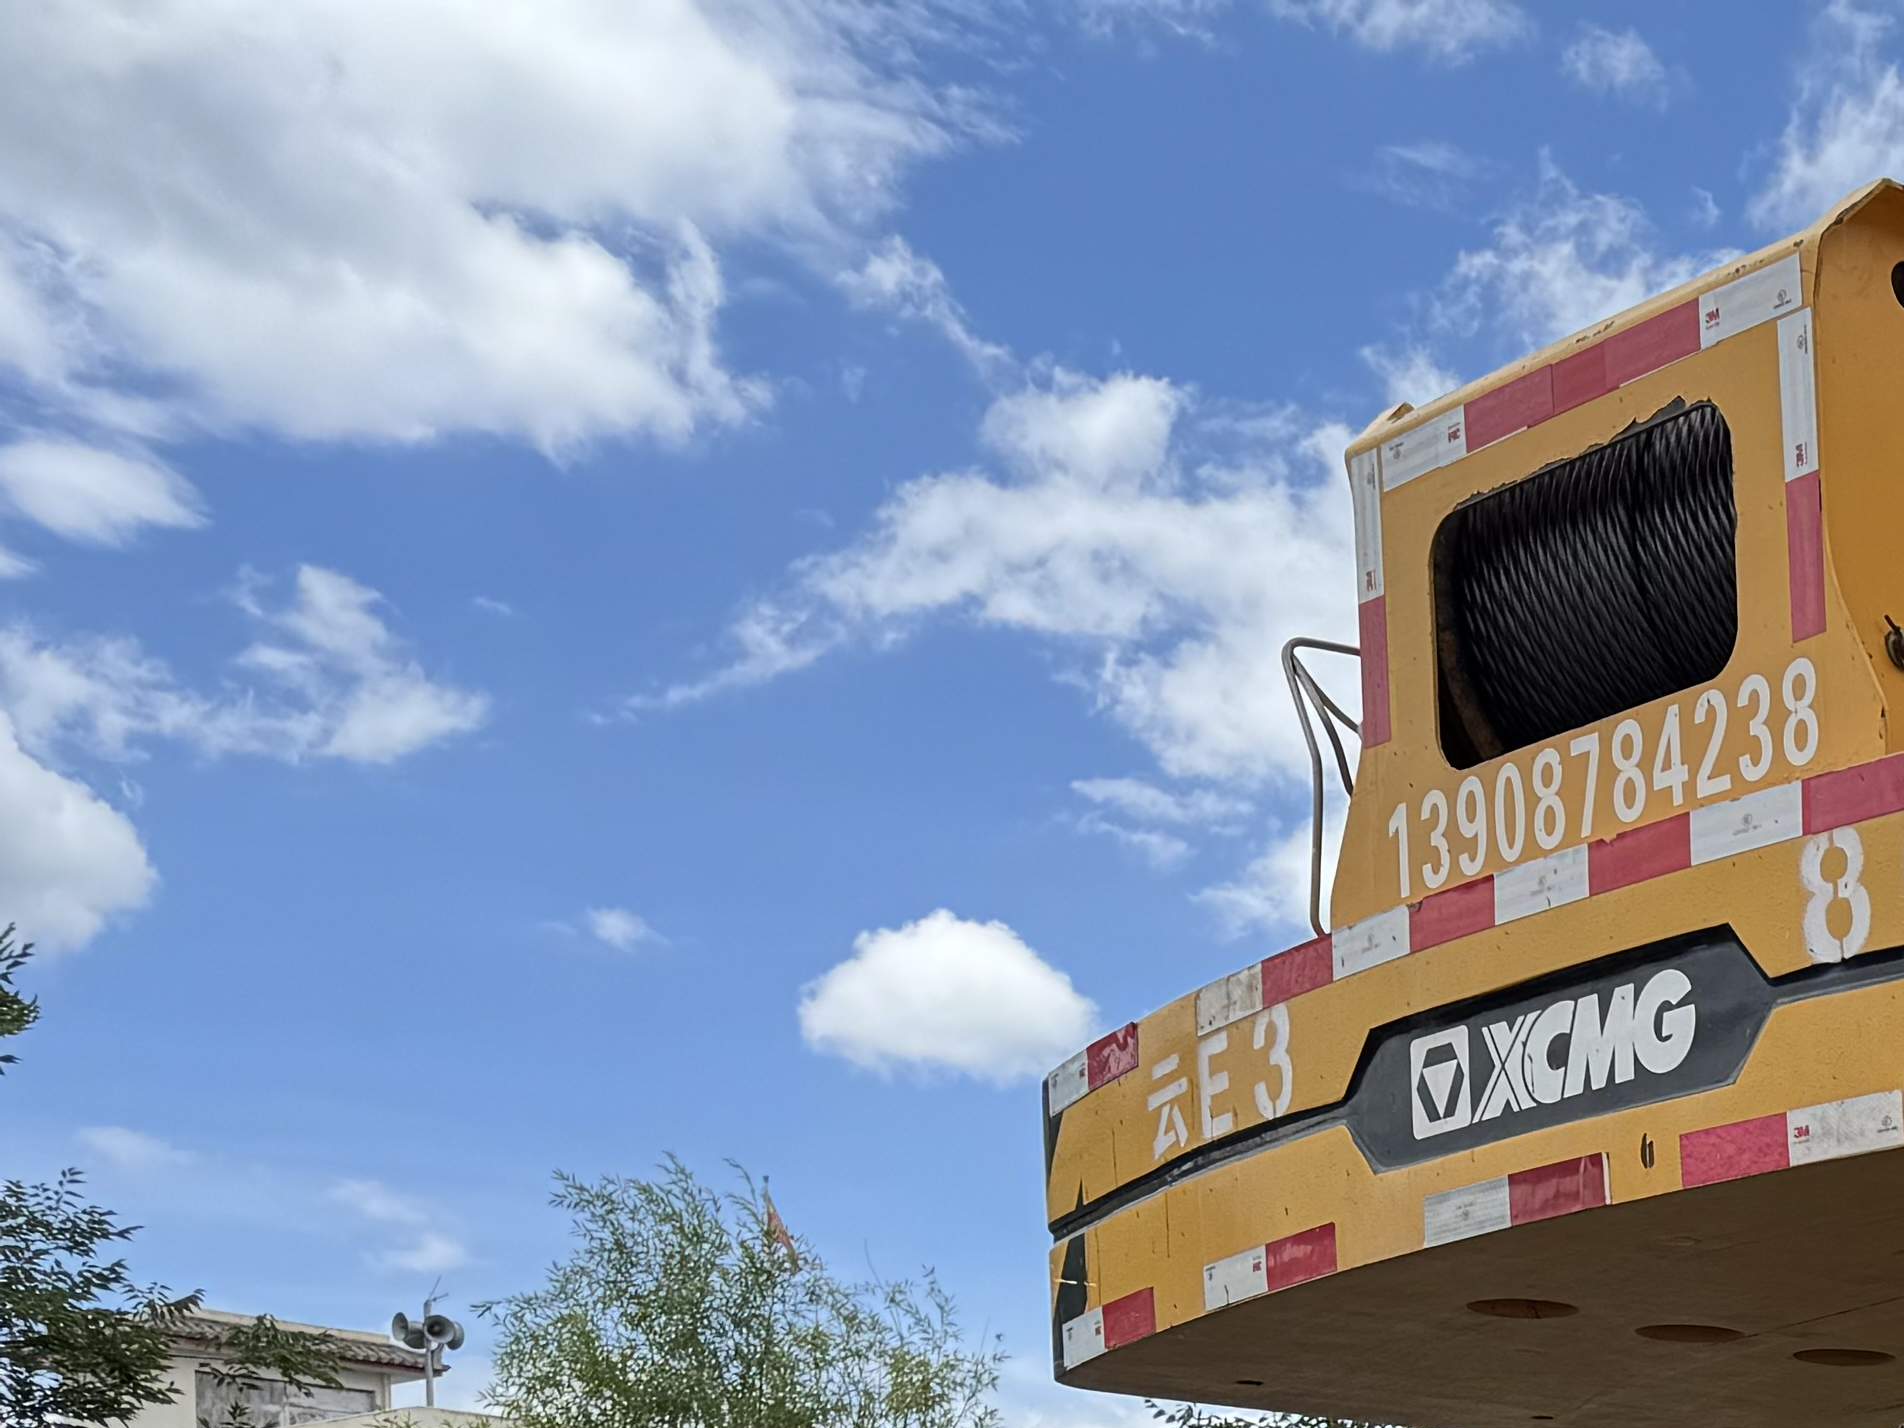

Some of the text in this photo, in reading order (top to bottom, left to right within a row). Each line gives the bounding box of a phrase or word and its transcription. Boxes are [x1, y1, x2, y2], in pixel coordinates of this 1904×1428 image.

[1705, 308, 1720, 324] 3M
[1388, 657, 1819, 898] 13908784238
[1472, 968, 1696, 1124] XCMG
[1794, 1125, 1811, 1139] 3M
